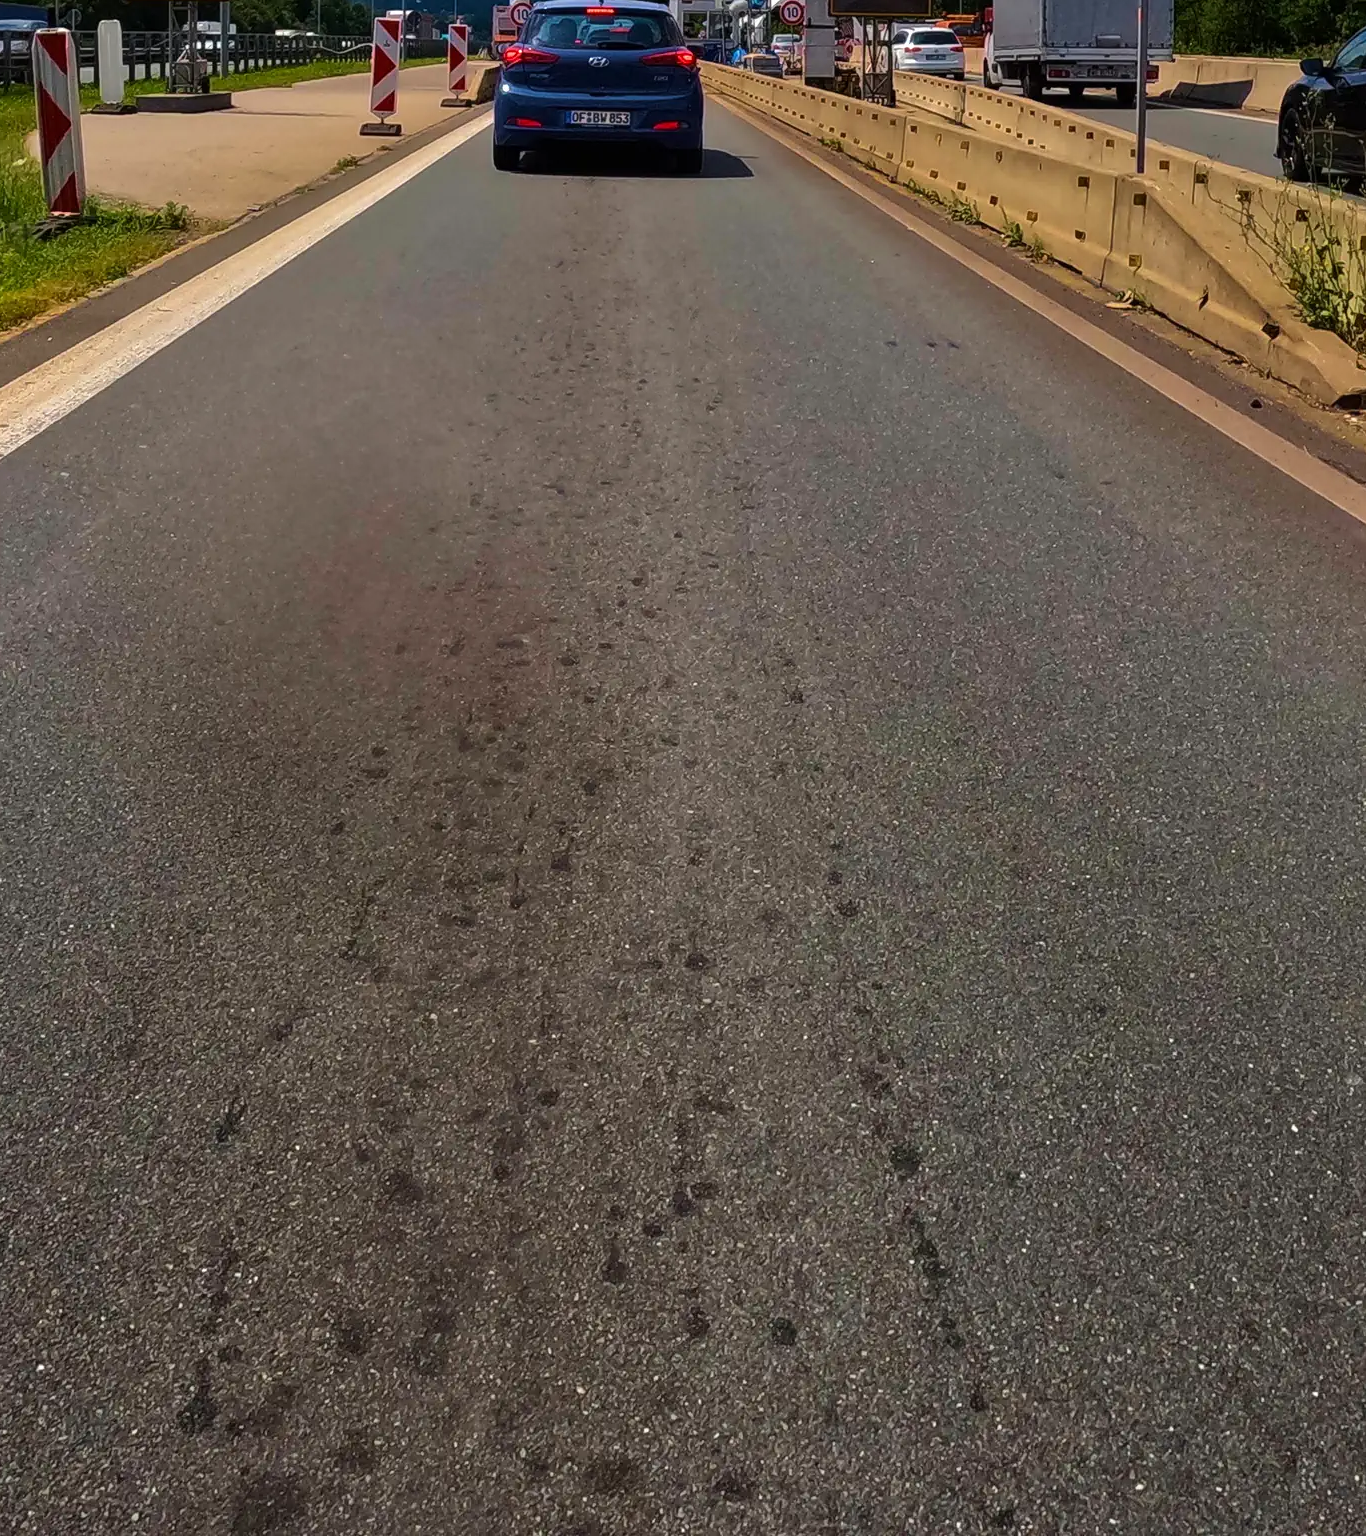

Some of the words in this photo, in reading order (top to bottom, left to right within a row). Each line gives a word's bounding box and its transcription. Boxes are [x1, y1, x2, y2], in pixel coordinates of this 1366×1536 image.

[516, 8, 529, 21] 10
[786, 6, 799, 19] 10
[572, 112, 587, 123] OF
[593, 113, 607, 124] BW
[609, 114, 629, 124] 853
